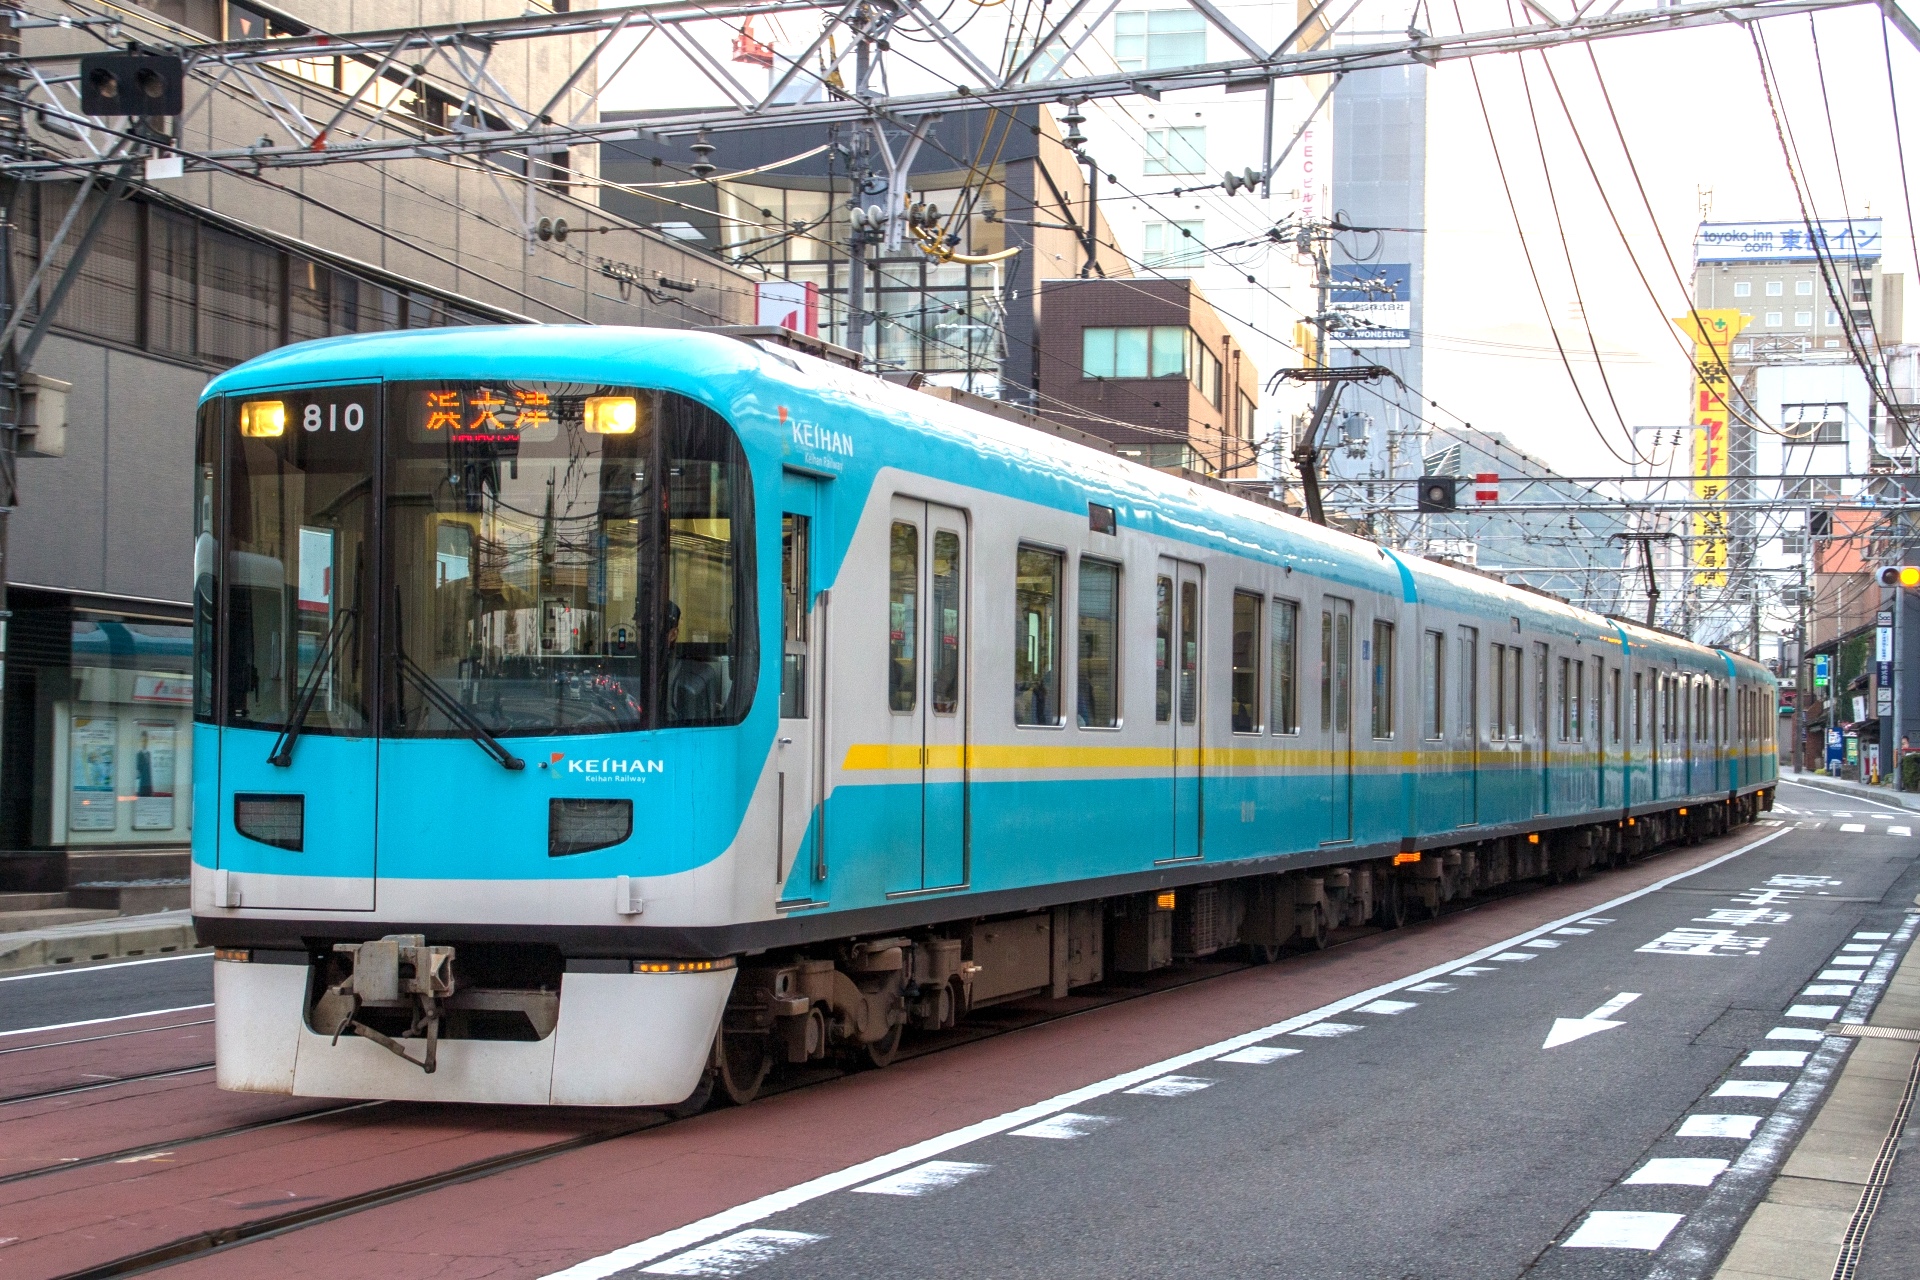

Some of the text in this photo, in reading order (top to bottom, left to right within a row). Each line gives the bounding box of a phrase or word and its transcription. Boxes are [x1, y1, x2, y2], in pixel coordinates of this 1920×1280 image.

[1779, 228, 1878, 252] 東横イン
[303, 403, 364, 432] 810
[427, 391, 550, 429] 浜大津
[792, 421, 853, 457] KEIHAN
[568, 758, 664, 773] KEIHAN
[615, 775, 646, 784] Railway
